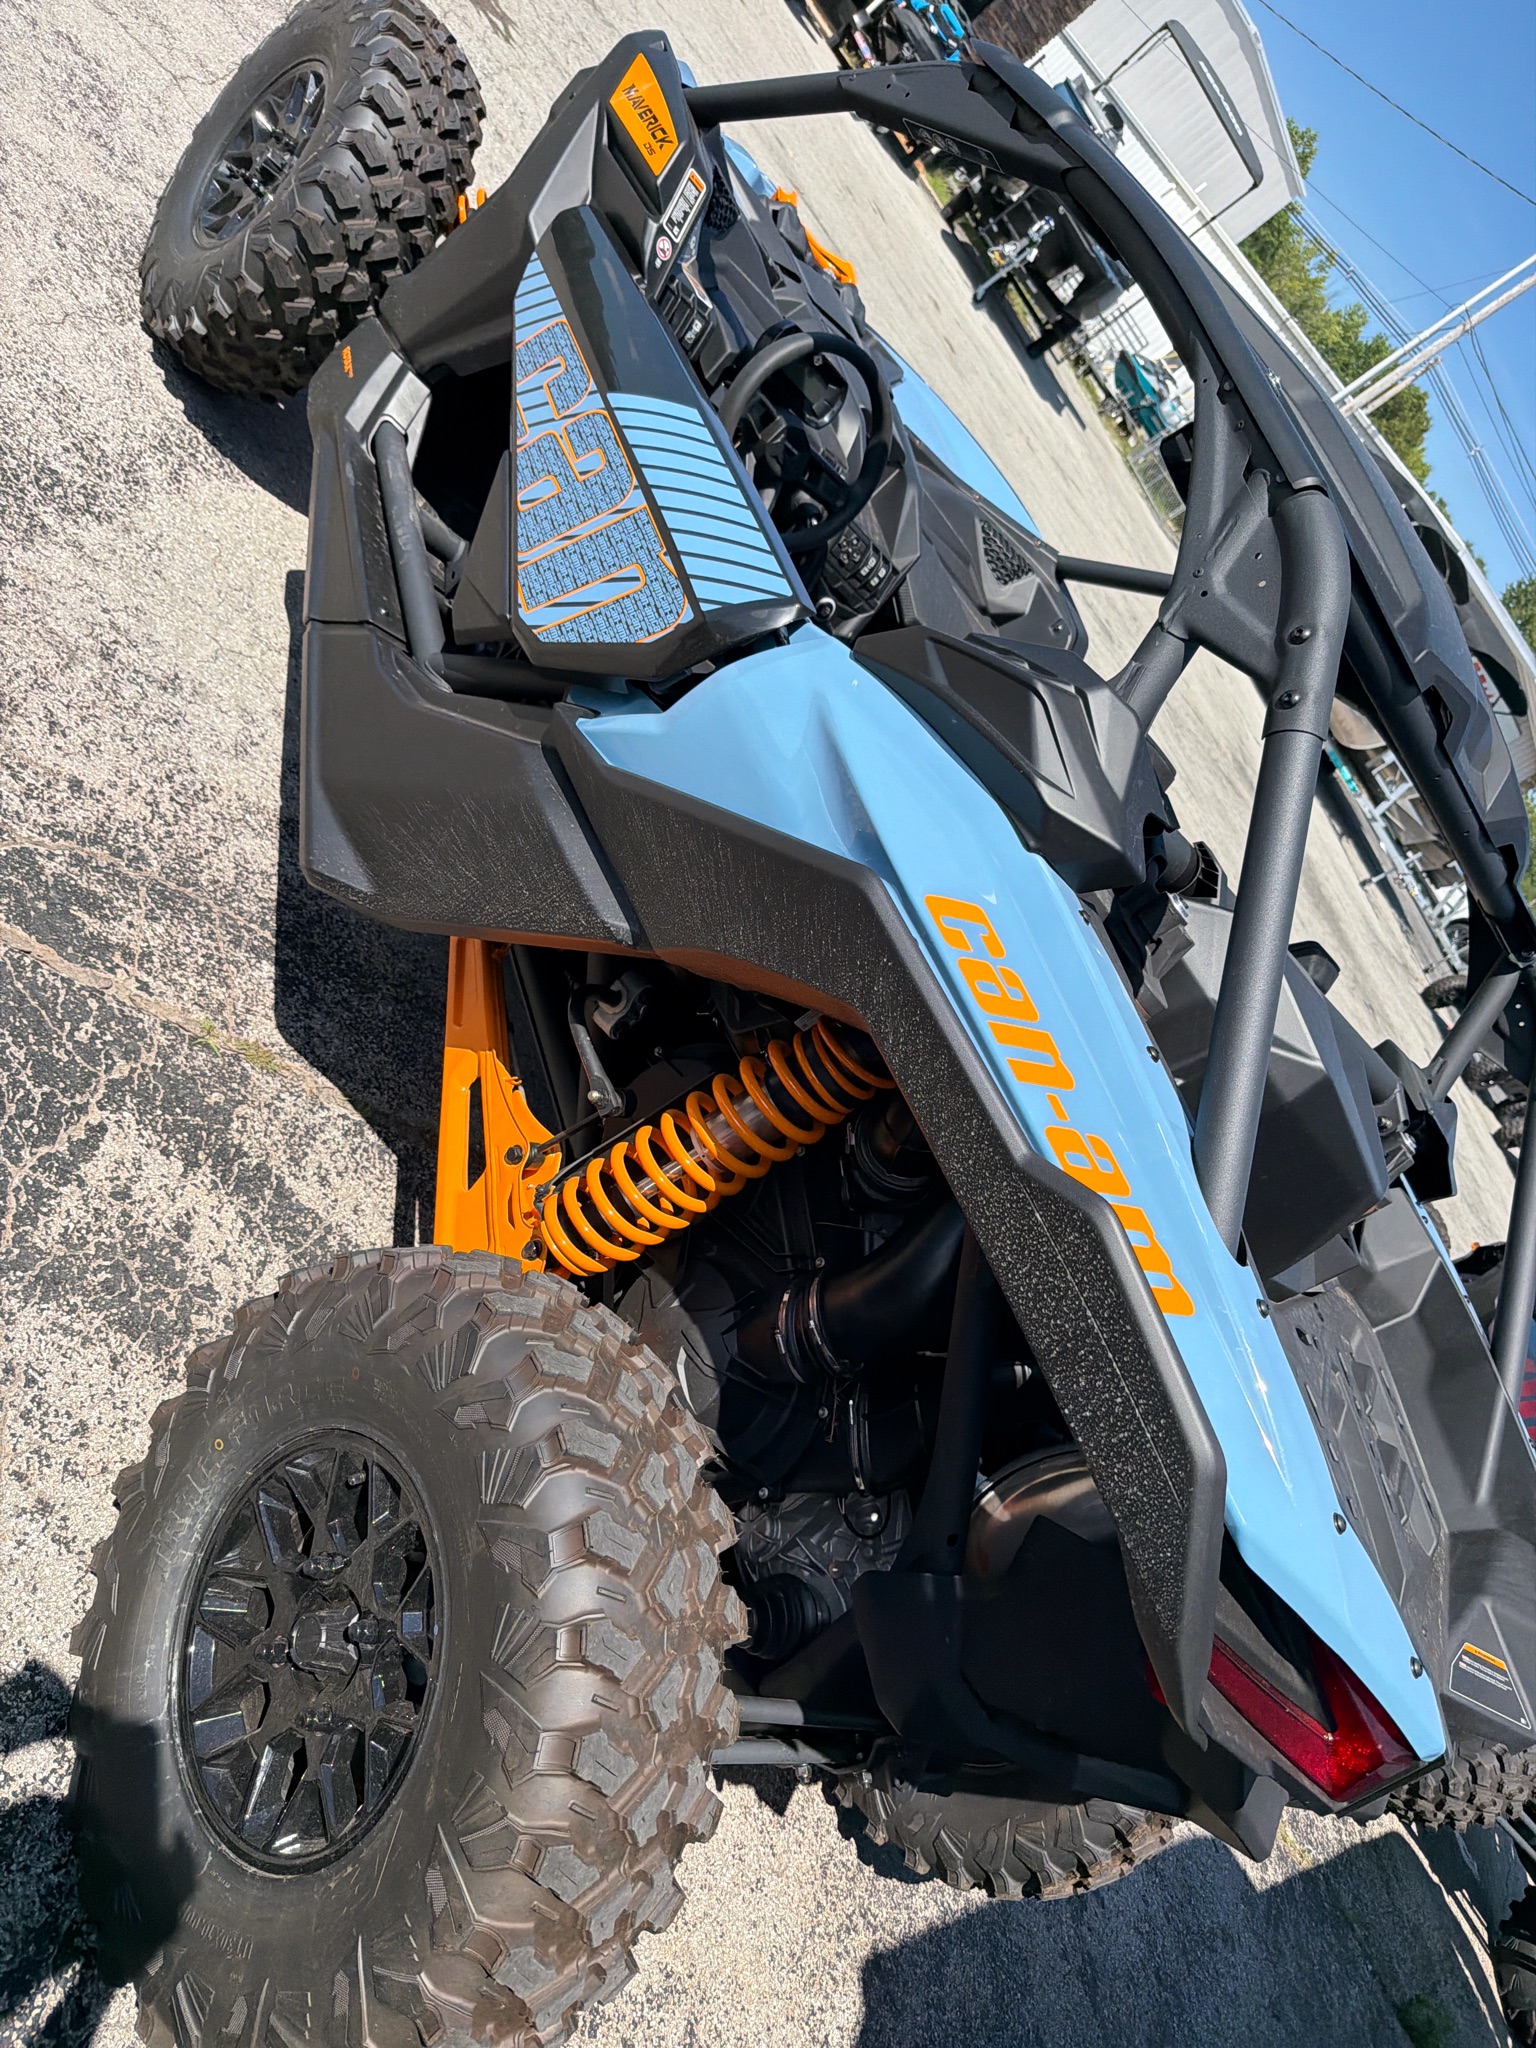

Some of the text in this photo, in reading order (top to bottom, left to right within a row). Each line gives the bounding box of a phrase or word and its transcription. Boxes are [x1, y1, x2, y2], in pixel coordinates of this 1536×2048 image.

[622, 83, 675, 151] MAVERICK
[643, 142, 656, 156] DS
[924, 895, 1195, 1317] can-am
